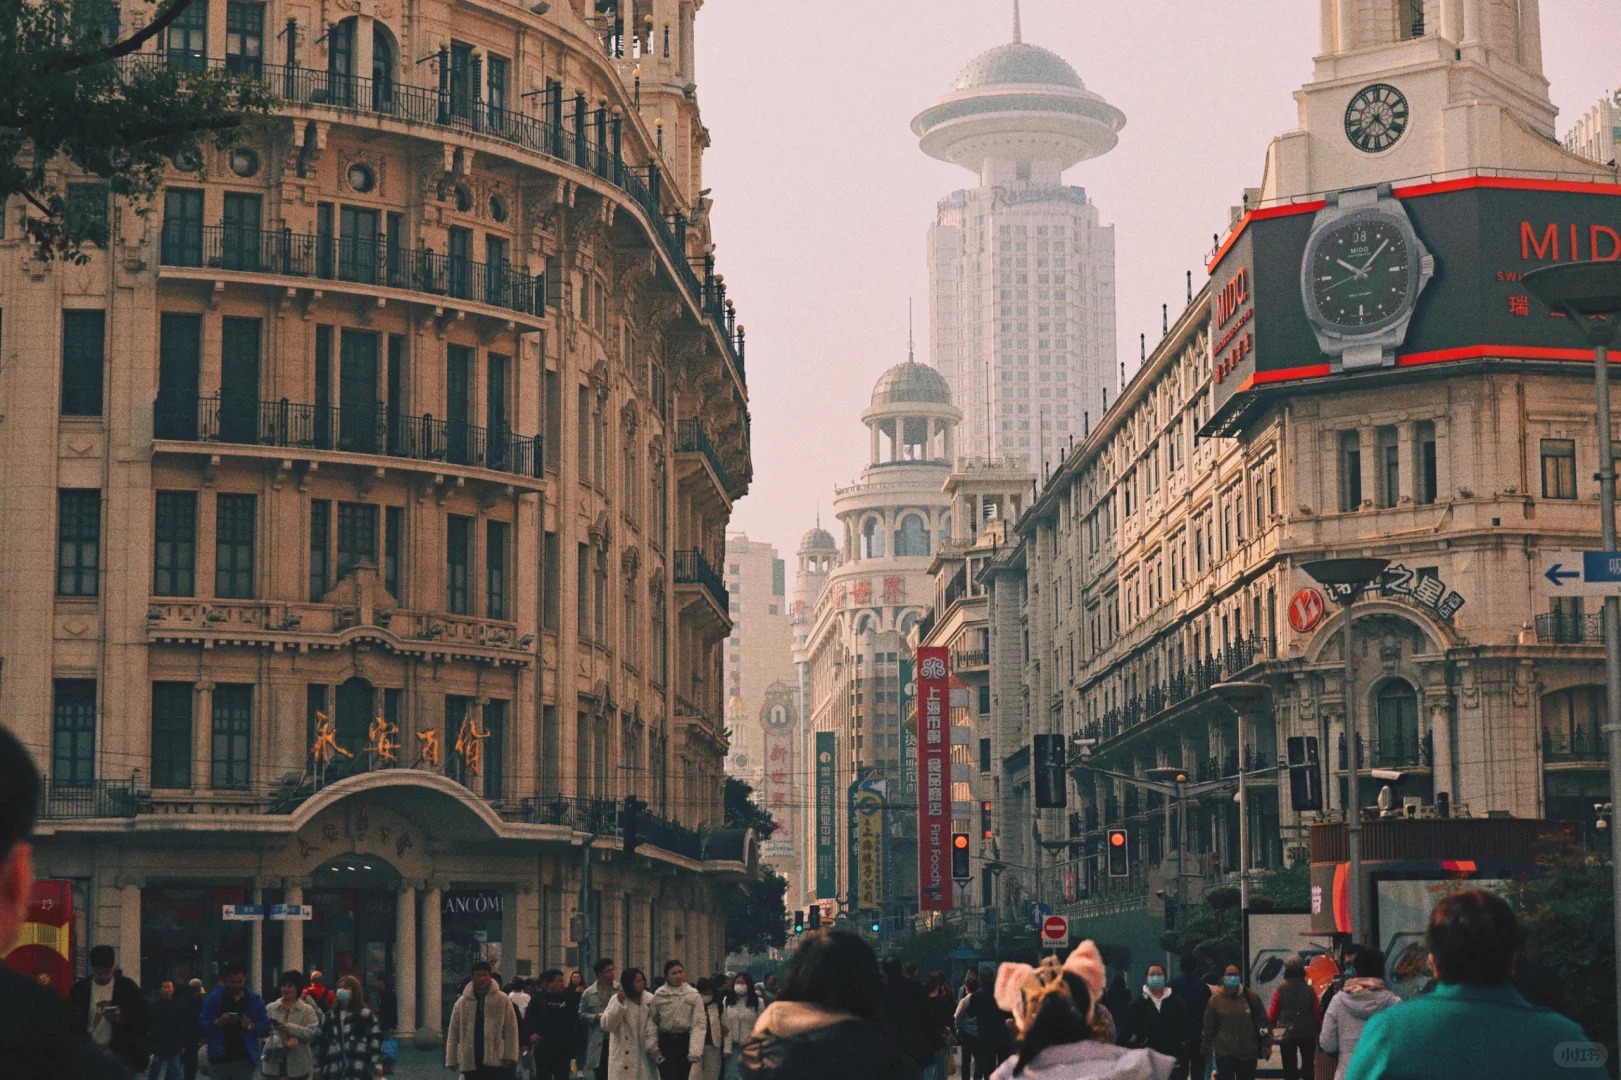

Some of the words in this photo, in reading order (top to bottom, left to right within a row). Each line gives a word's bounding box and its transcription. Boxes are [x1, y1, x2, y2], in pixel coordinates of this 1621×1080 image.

[1350, 246, 1369, 254] MIDO
[1520, 220, 1621, 262] MID
[832, 576, 908, 607] 新世界
[927, 687, 942, 816] 上海市第一食品商店
[930, 824, 941, 846] First
[930, 849, 942, 900] Foodhll
[442, 893, 504, 913] ANCÔM
